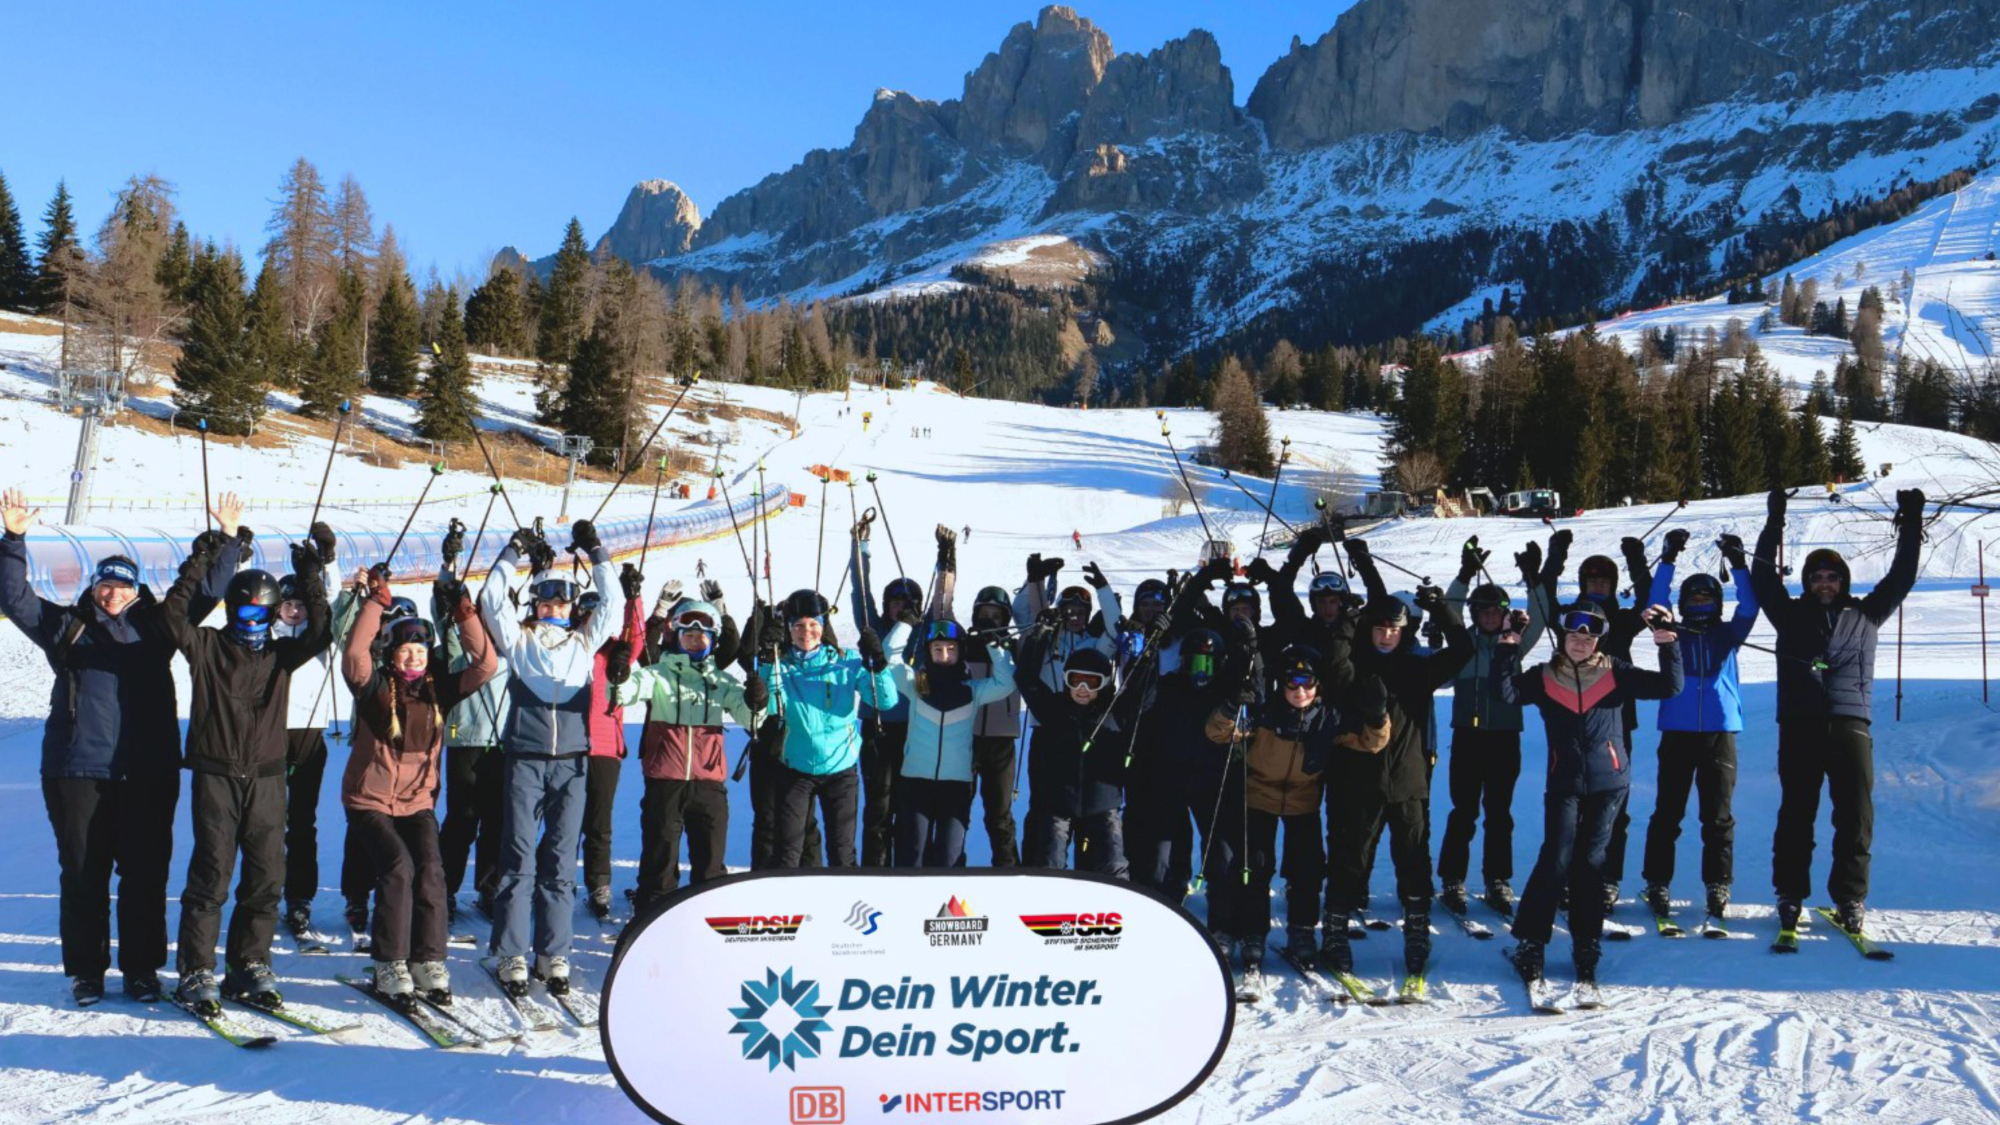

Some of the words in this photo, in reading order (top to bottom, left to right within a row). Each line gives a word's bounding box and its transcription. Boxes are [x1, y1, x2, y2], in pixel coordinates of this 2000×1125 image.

[751, 914, 805, 935] DSV
[928, 919, 984, 932] SNOWBOARD
[1076, 912, 1123, 937] SIS
[929, 933, 984, 947] GERMANY
[1044, 937, 1079, 945] STIFTUNG
[1080, 936, 1122, 944] SICHERHEIT
[837, 976, 936, 1011] Dein
[950, 974, 1102, 1009] Winter.
[838, 1023, 937, 1058] Dein
[946, 1021, 1080, 1062] Sport.
[796, 1092, 839, 1119] DB
[905, 1090, 1066, 1113] INTERSPORT
